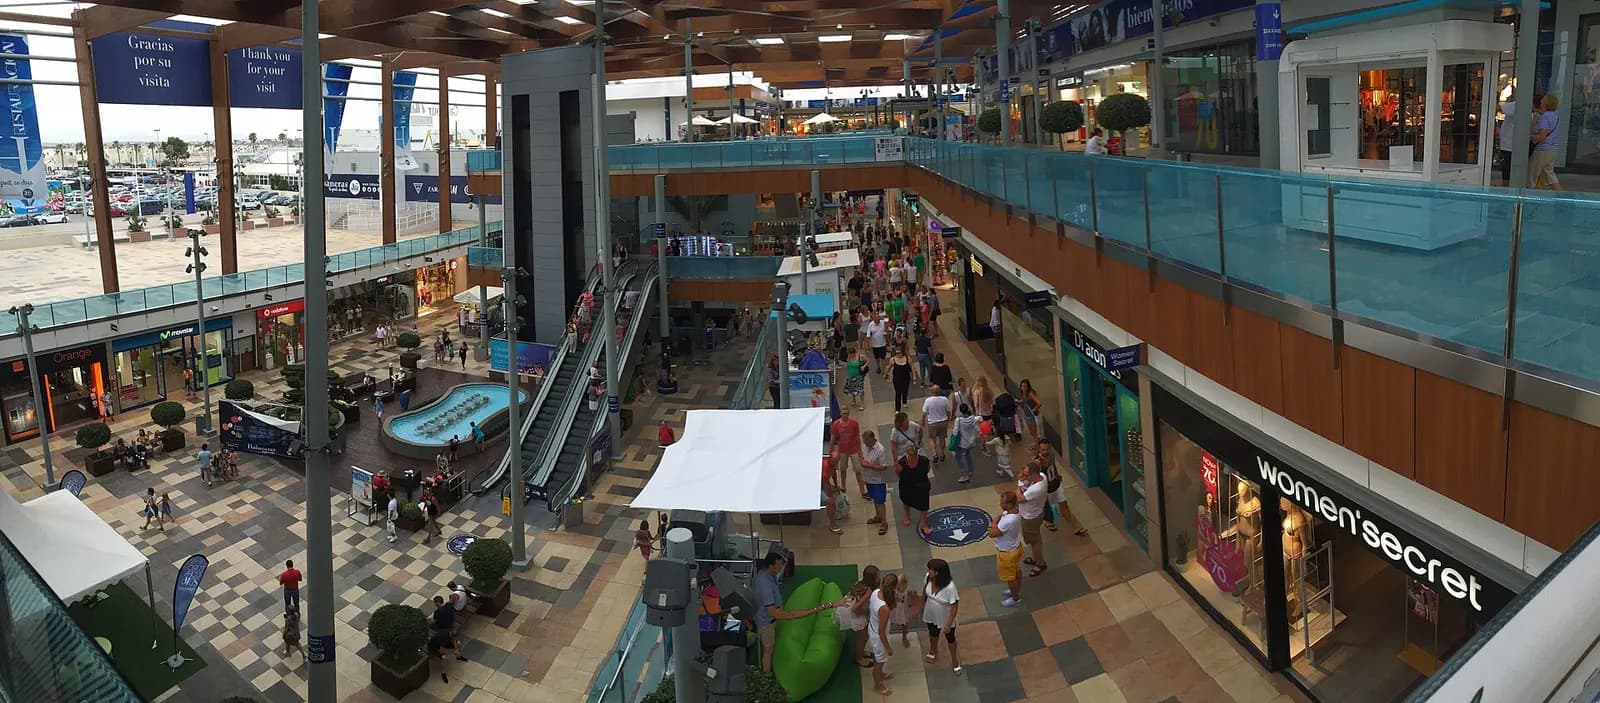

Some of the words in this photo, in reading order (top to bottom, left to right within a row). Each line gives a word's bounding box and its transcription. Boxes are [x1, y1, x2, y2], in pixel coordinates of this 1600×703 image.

[128, 33, 174, 52] Gracias
[134, 56, 155, 70] por
[158, 58, 171, 68] su
[241, 47, 272, 61] Thank
[274, 51, 291, 64] you
[247, 62, 261, 74] for
[264, 66, 285, 79] your
[139, 73, 170, 88] visita
[256, 81, 275, 93] visit
[171, 326, 194, 337] movistar
[1074, 330, 1084, 351] Di
[54, 348, 92, 363] Orange
[1257, 456, 1482, 612] women'secret
